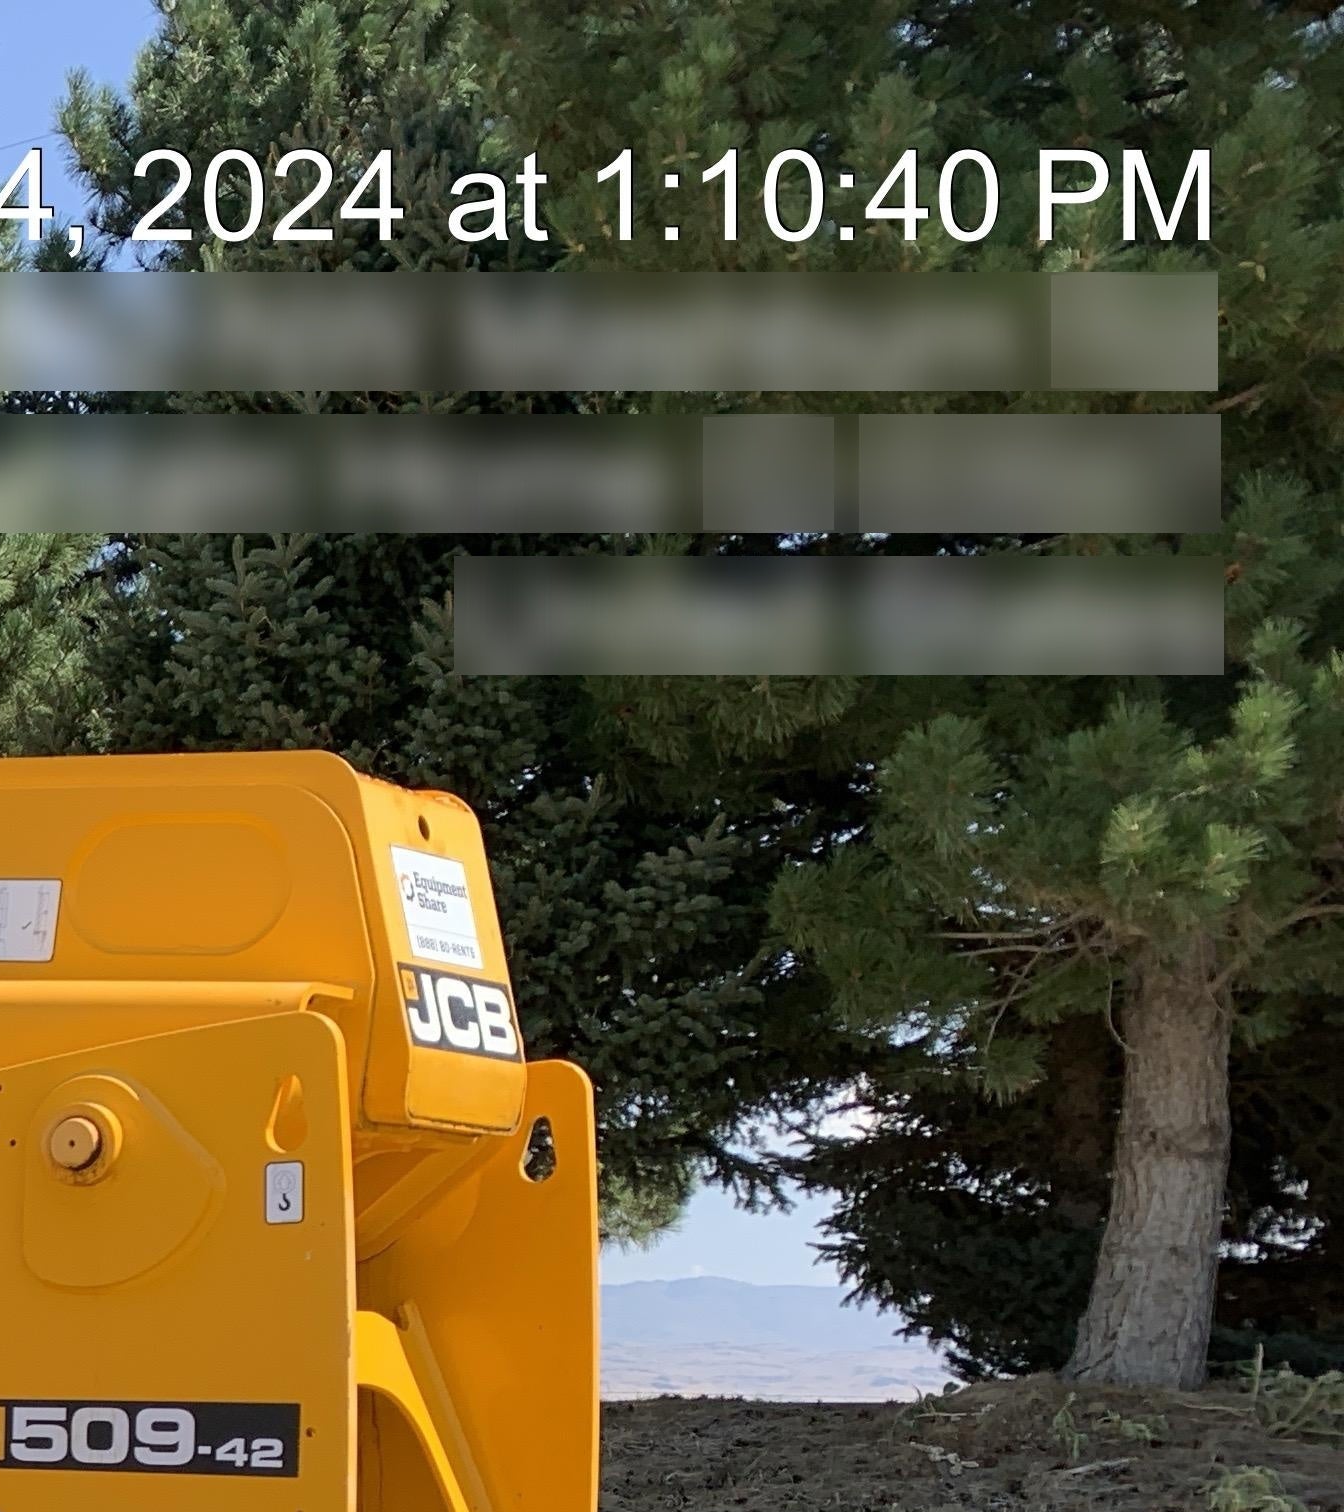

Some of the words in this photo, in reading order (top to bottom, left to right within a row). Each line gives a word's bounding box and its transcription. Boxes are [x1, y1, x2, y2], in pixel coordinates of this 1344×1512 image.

[413, 871, 468, 899] Equipment
[417, 892, 448, 914] Share
[408, 972, 518, 1056] JCB
[10, 1406, 284, 1469] 509-42
